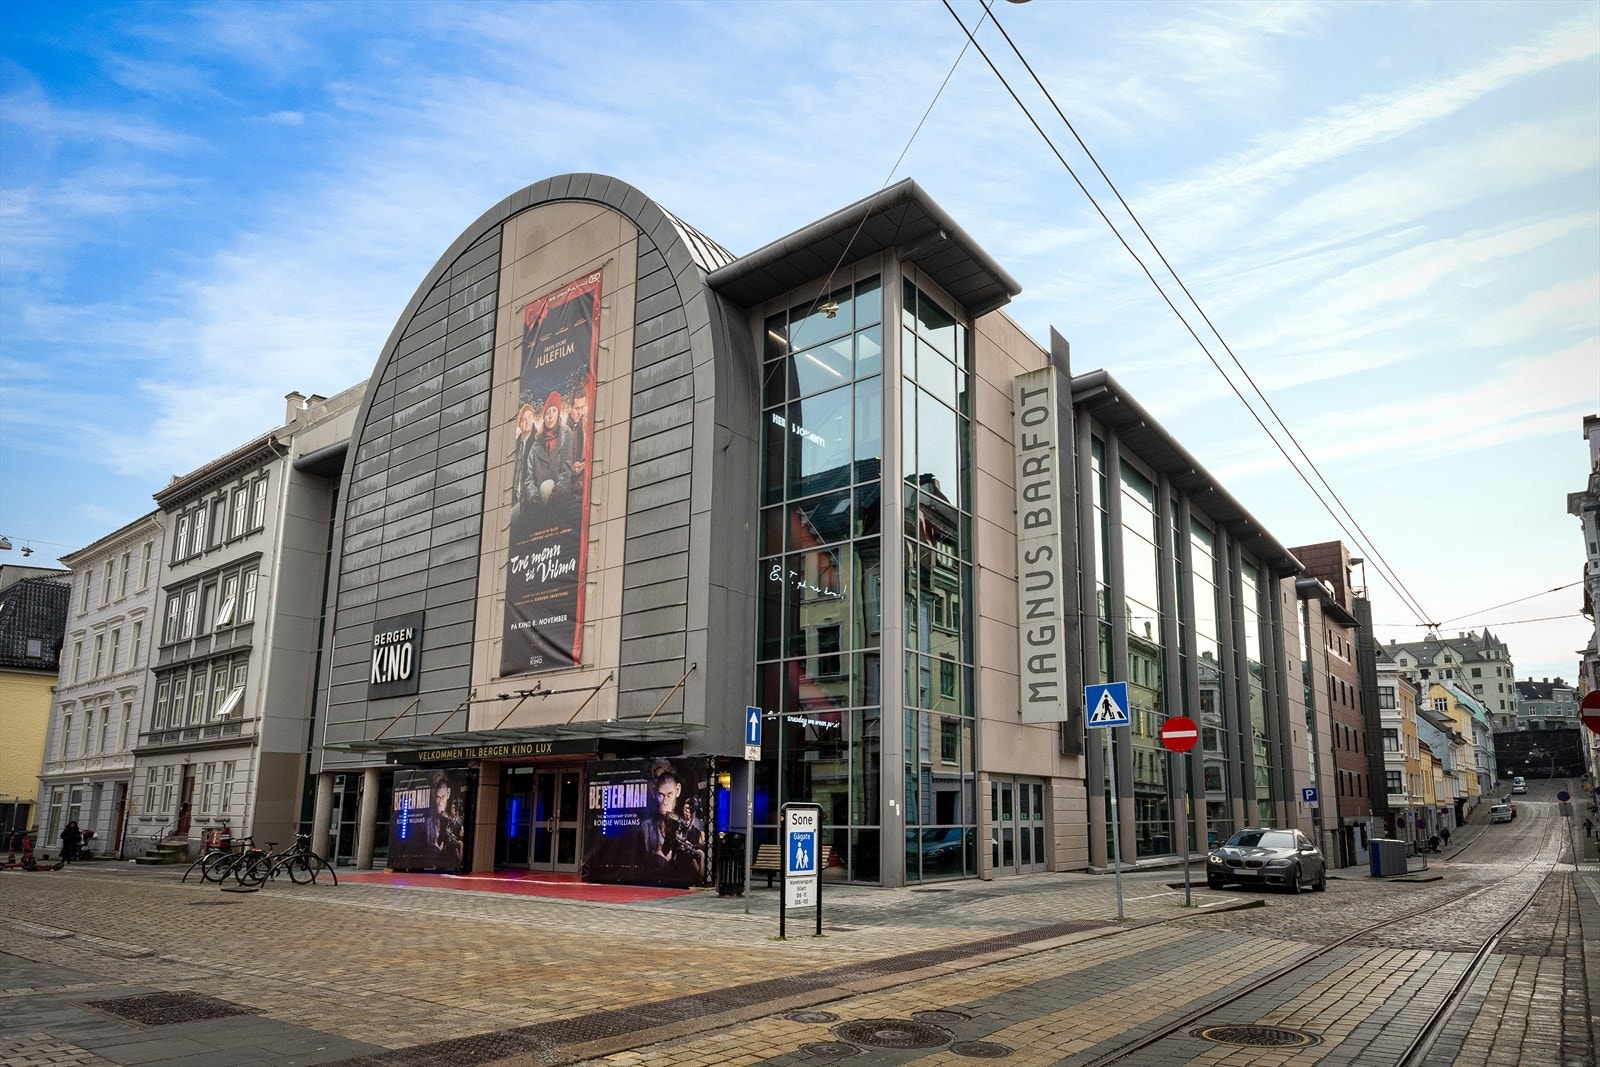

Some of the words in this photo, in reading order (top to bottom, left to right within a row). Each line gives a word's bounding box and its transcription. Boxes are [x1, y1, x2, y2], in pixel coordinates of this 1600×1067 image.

[535, 342, 574, 368] JULEFILM
[1020, 386, 1052, 531] BARFOT
[511, 555, 529, 574] Tre
[531, 544, 561, 565] menn
[525, 568, 535, 582] til
[537, 558, 576, 583] Vilma
[510, 621, 518, 631] PÅ
[518, 621, 531, 629] KINO
[538, 614, 568, 626] NOVEMBER
[1025, 544, 1058, 703] MAGNUS
[374, 628, 413, 646] BERGEN
[418, 749, 463, 761] VELKOMMEN
[465, 748, 476, 758] TIL
[478, 746, 509, 757] BERGEN
[511, 744, 533, 755] KINO
[536, 742, 552, 753] LUX
[589, 785, 624, 809] BETTER
[626, 784, 648, 808] MAN
[1305, 789, 1314, 800] P
[792, 813, 813, 826] Sone
[793, 832, 811, 842] Gågate
